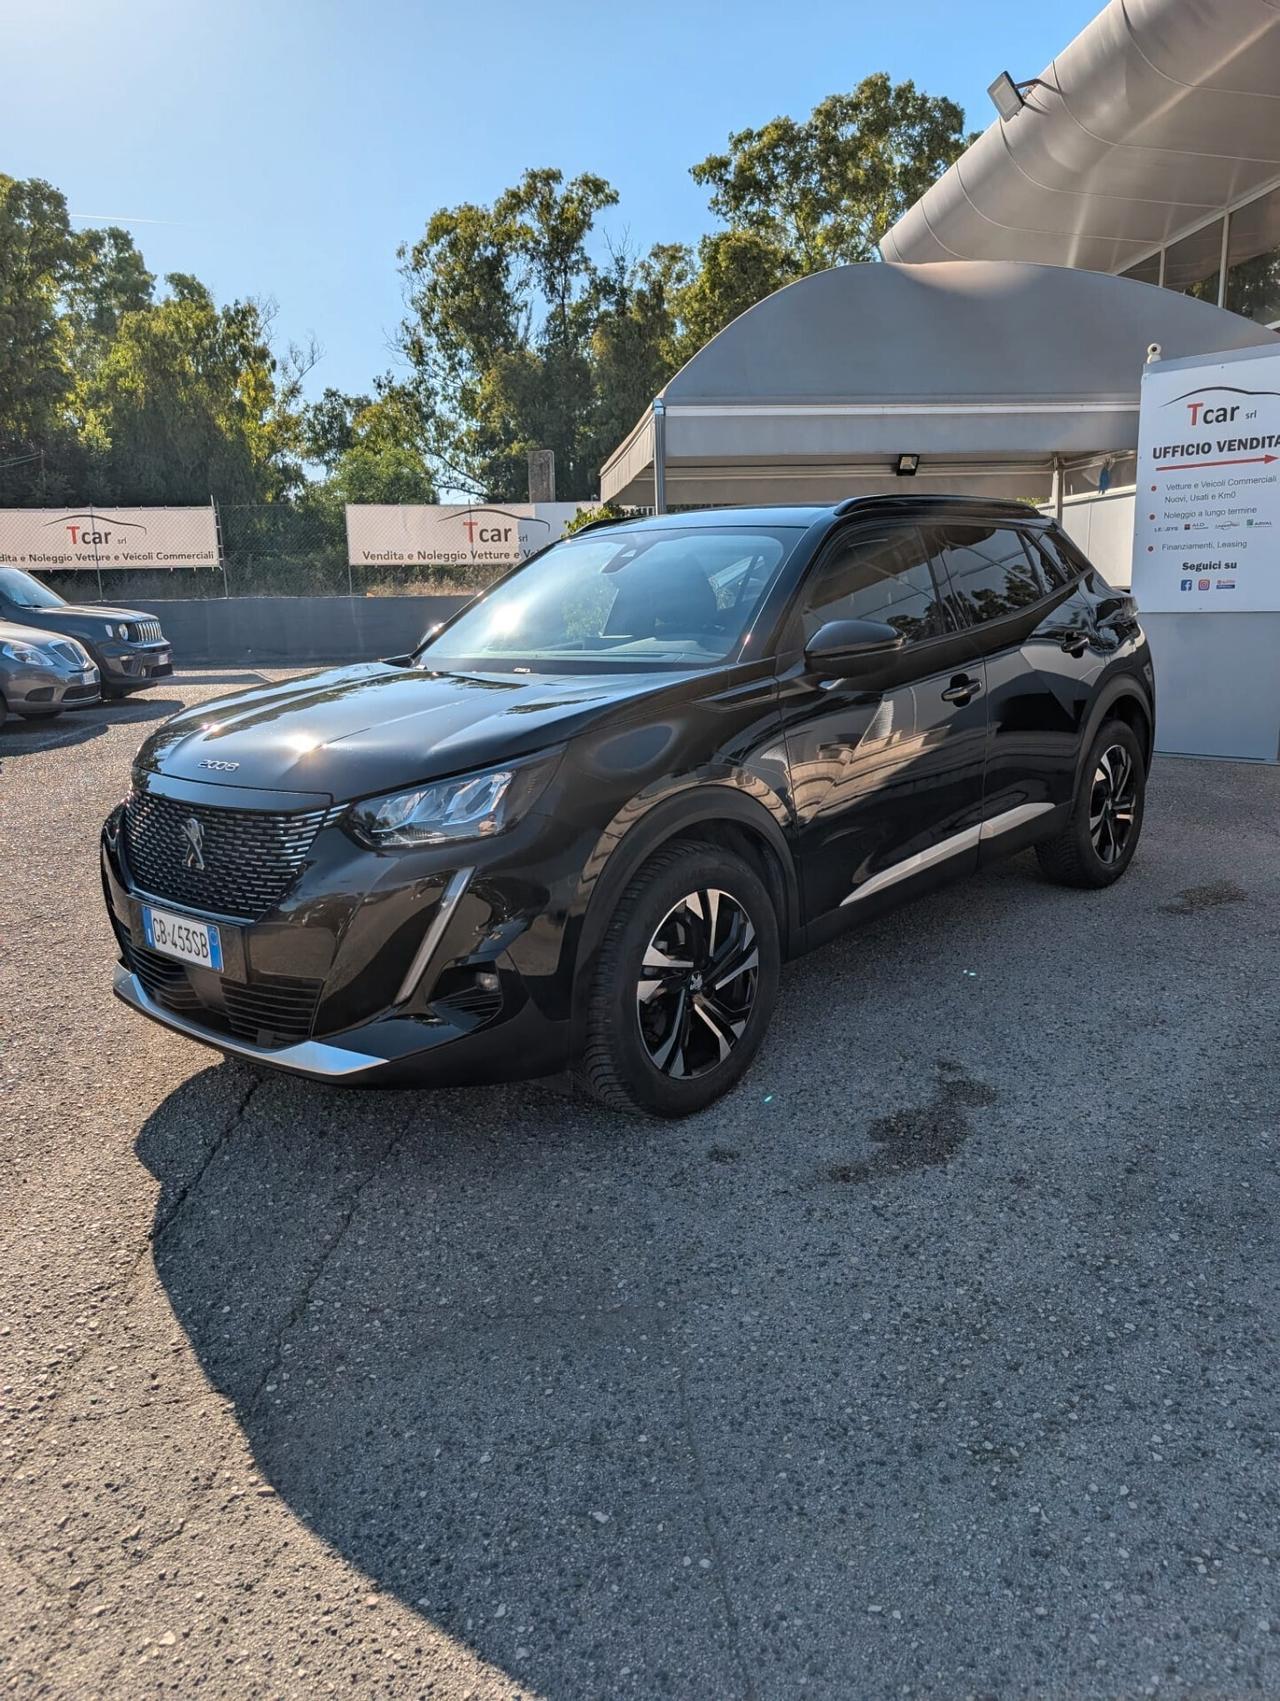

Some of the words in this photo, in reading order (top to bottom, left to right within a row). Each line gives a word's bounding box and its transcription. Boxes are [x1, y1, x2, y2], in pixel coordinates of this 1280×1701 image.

[1187, 403, 1240, 426] Tcar
[1245, 410, 1257, 419] srl
[1153, 442, 1212, 459] UFFICIO
[1166, 482, 1192, 491] Vetture
[1201, 479, 1226, 488] Veicoli
[1228, 475, 1277, 486] Commerciali
[1190, 493, 1209, 502] Usati
[1164, 510, 1196, 519] Noleggio
[1205, 509, 1226, 518] lungo
[1228, 507, 1257, 515] termine
[66, 525, 112, 545] Tcar
[463, 521, 512, 544] Tcar
[518, 534, 528, 542] srl
[1217, 540, 1248, 549] Leasing
[29, 553, 72, 564] Noleggio
[75, 553, 111, 562] Vetture
[122, 552, 154, 561] Veicoli
[156, 551, 214, 561] Commerciali
[362, 551, 404, 561] Vendita
[418, 551, 467, 563] Noleggio
[471, 551, 510, 560] Vetture
[1182, 560, 1221, 572] Seguici
[1224, 561, 1237, 569] su
[198, 759, 240, 771] 2008
